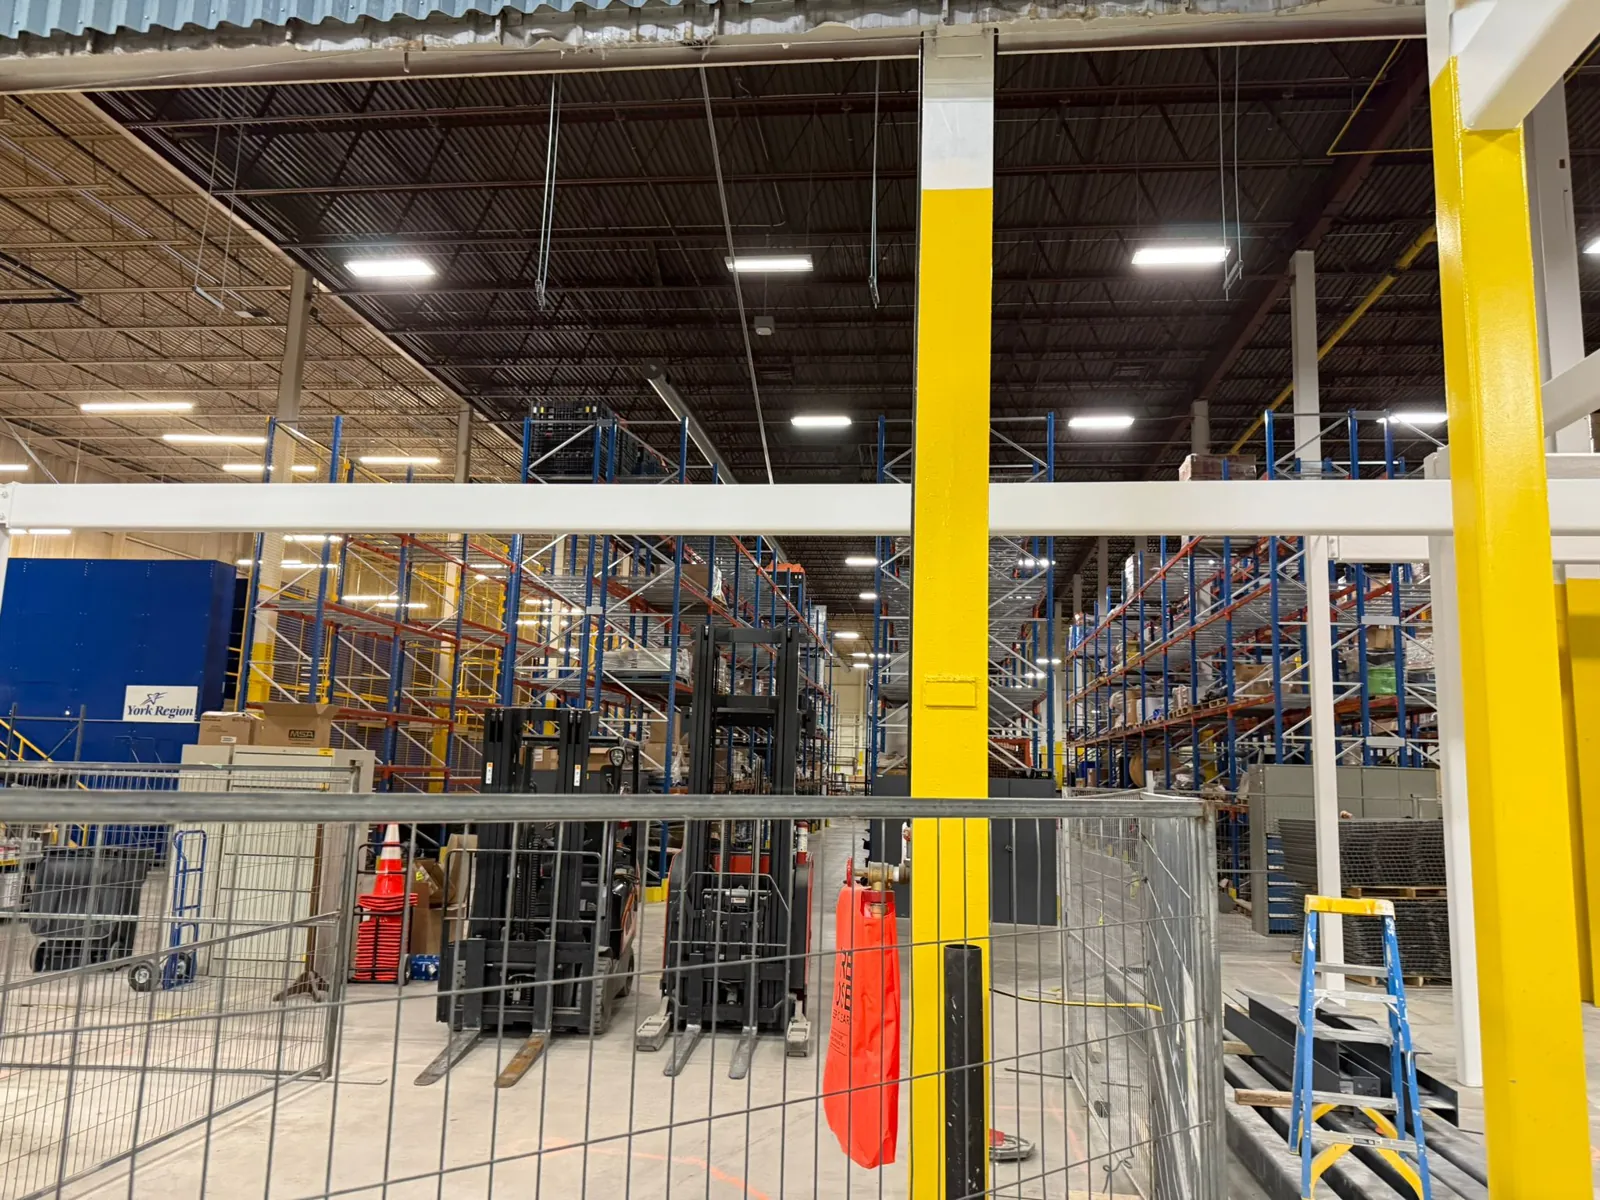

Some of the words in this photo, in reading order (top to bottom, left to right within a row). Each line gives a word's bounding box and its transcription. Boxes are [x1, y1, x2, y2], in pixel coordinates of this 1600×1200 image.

[127, 704, 153, 717] York
[154, 705, 194, 720] Region
[290, 730, 314, 739] MSA
